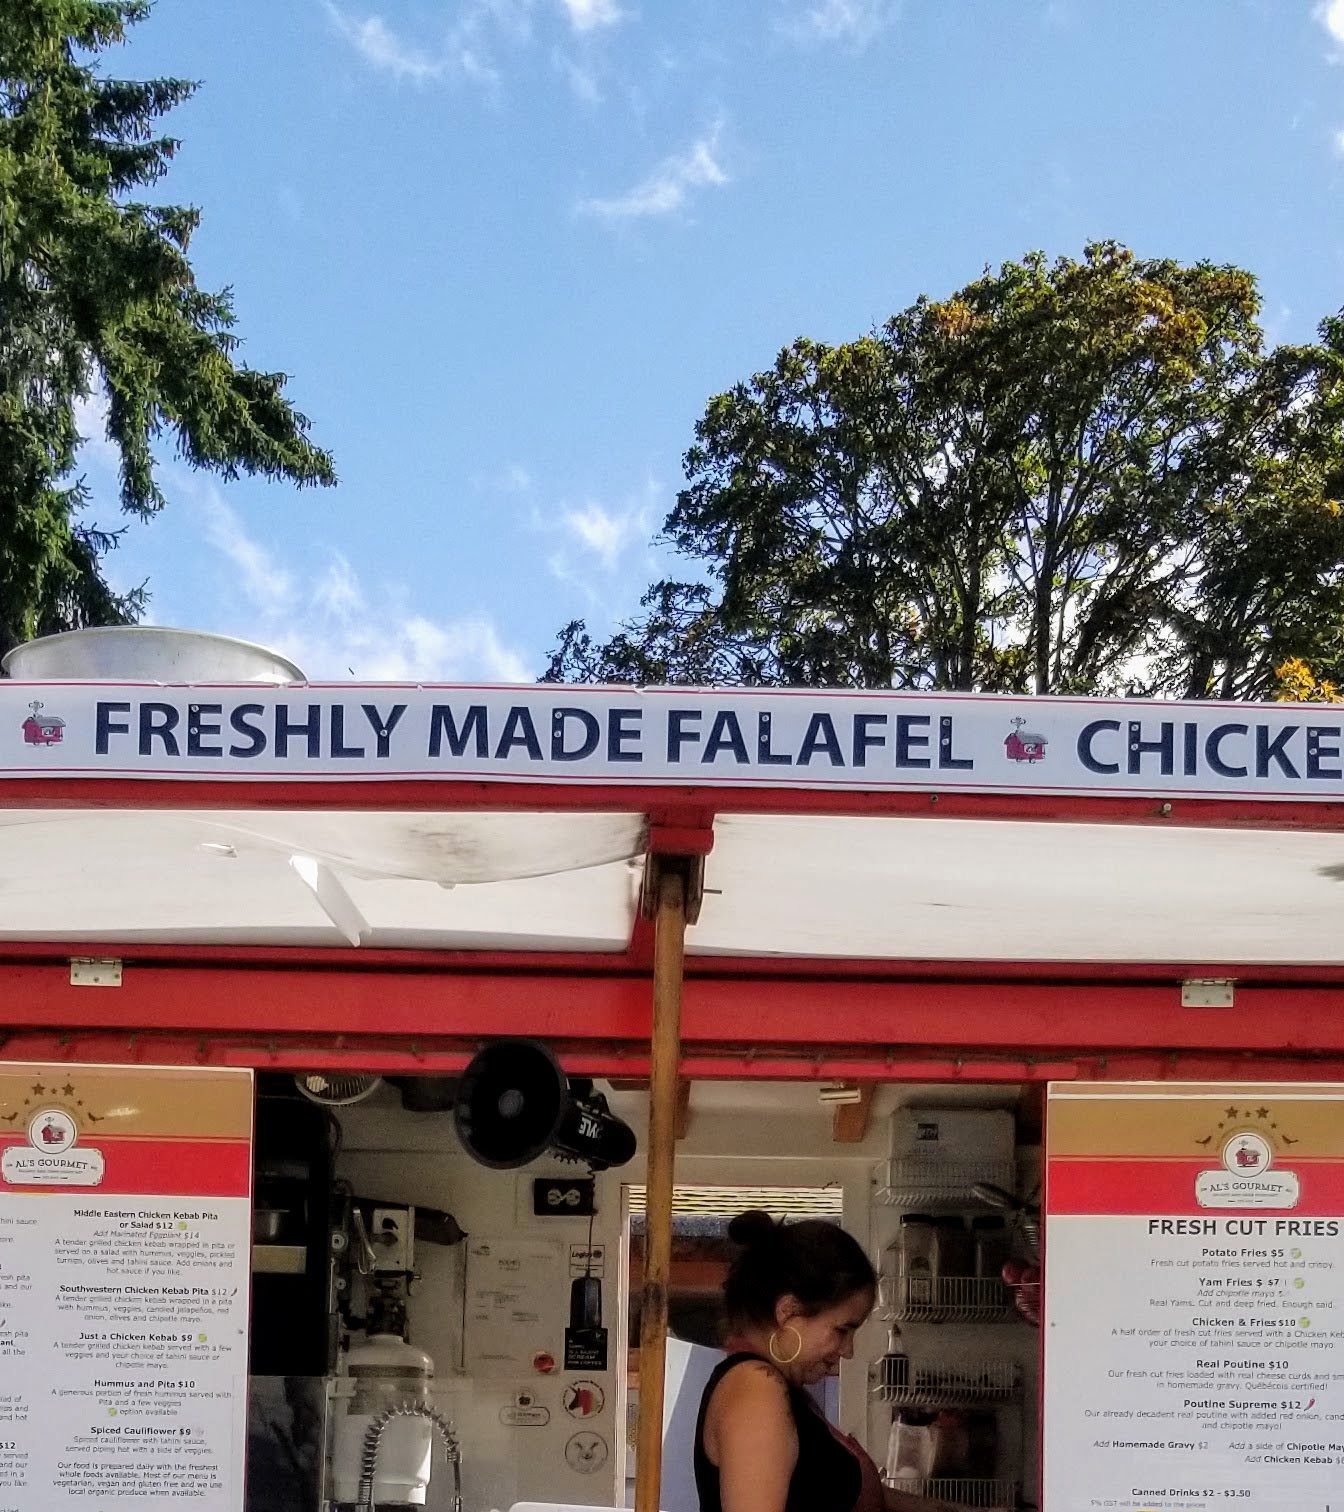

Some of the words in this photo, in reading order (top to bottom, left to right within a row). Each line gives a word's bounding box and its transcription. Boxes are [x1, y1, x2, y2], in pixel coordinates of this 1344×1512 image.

[96, 702, 407, 758] FRESHLY
[428, 704, 642, 762] MADE
[666, 709, 973, 770] FALAFEL
[16, 1159, 34, 1168] AL'S
[38, 1159, 88, 1169] GOURMET
[1210, 1183, 1229, 1192] AL'S
[1232, 1182, 1284, 1192] GOURMET
[104, 1210, 135, 1219] Eastern
[138, 1211, 170, 1219] Chicken
[174, 1212, 199, 1220] Kebab
[202, 1212, 217, 1220] Pita
[130, 1221, 153, 1229] Salad
[156, 1222, 172, 1230] $12
[1149, 1219, 1216, 1235] FRESH
[1226, 1220, 1267, 1235] CUT
[1276, 1220, 1338, 1236] FRIES
[1202, 1248, 1236, 1257] Potato
[1241, 1249, 1266, 1257] Fries
[1271, 1249, 1283, 1258] $5
[1199, 1278, 1222, 1286] Yam
[1226, 1278, 1252, 1287] Fries
[1192, 1317, 1234, 1327] Chicken
[1238, 1318, 1246, 1326] &
[1250, 1318, 1276, 1327] Fries
[1278, 1319, 1295, 1327] $10
[79, 1332, 98, 1340] Just
[110, 1333, 145, 1341] Chicken
[149, 1333, 177, 1341] Kebab
[181, 1334, 192, 1342] $9
[1196, 1359, 1219, 1368] Real
[1224, 1360, 1264, 1369] Poutine
[1268, 1361, 1288, 1370] $10
[94, 1379, 134, 1388] Hummus
[138, 1380, 154, 1388] and
[158, 1380, 175, 1388] Pita
[178, 1380, 194, 1389] $10
[1184, 1400, 1224, 1409] Poutine
[1228, 1400, 1276, 1410] Supreme
[1280, 1401, 1300, 1410] $12
[1132, 1488, 1166, 1496] Canned
[1170, 1489, 1199, 1497] Drinks
[1202, 1489, 1214, 1497] $2
